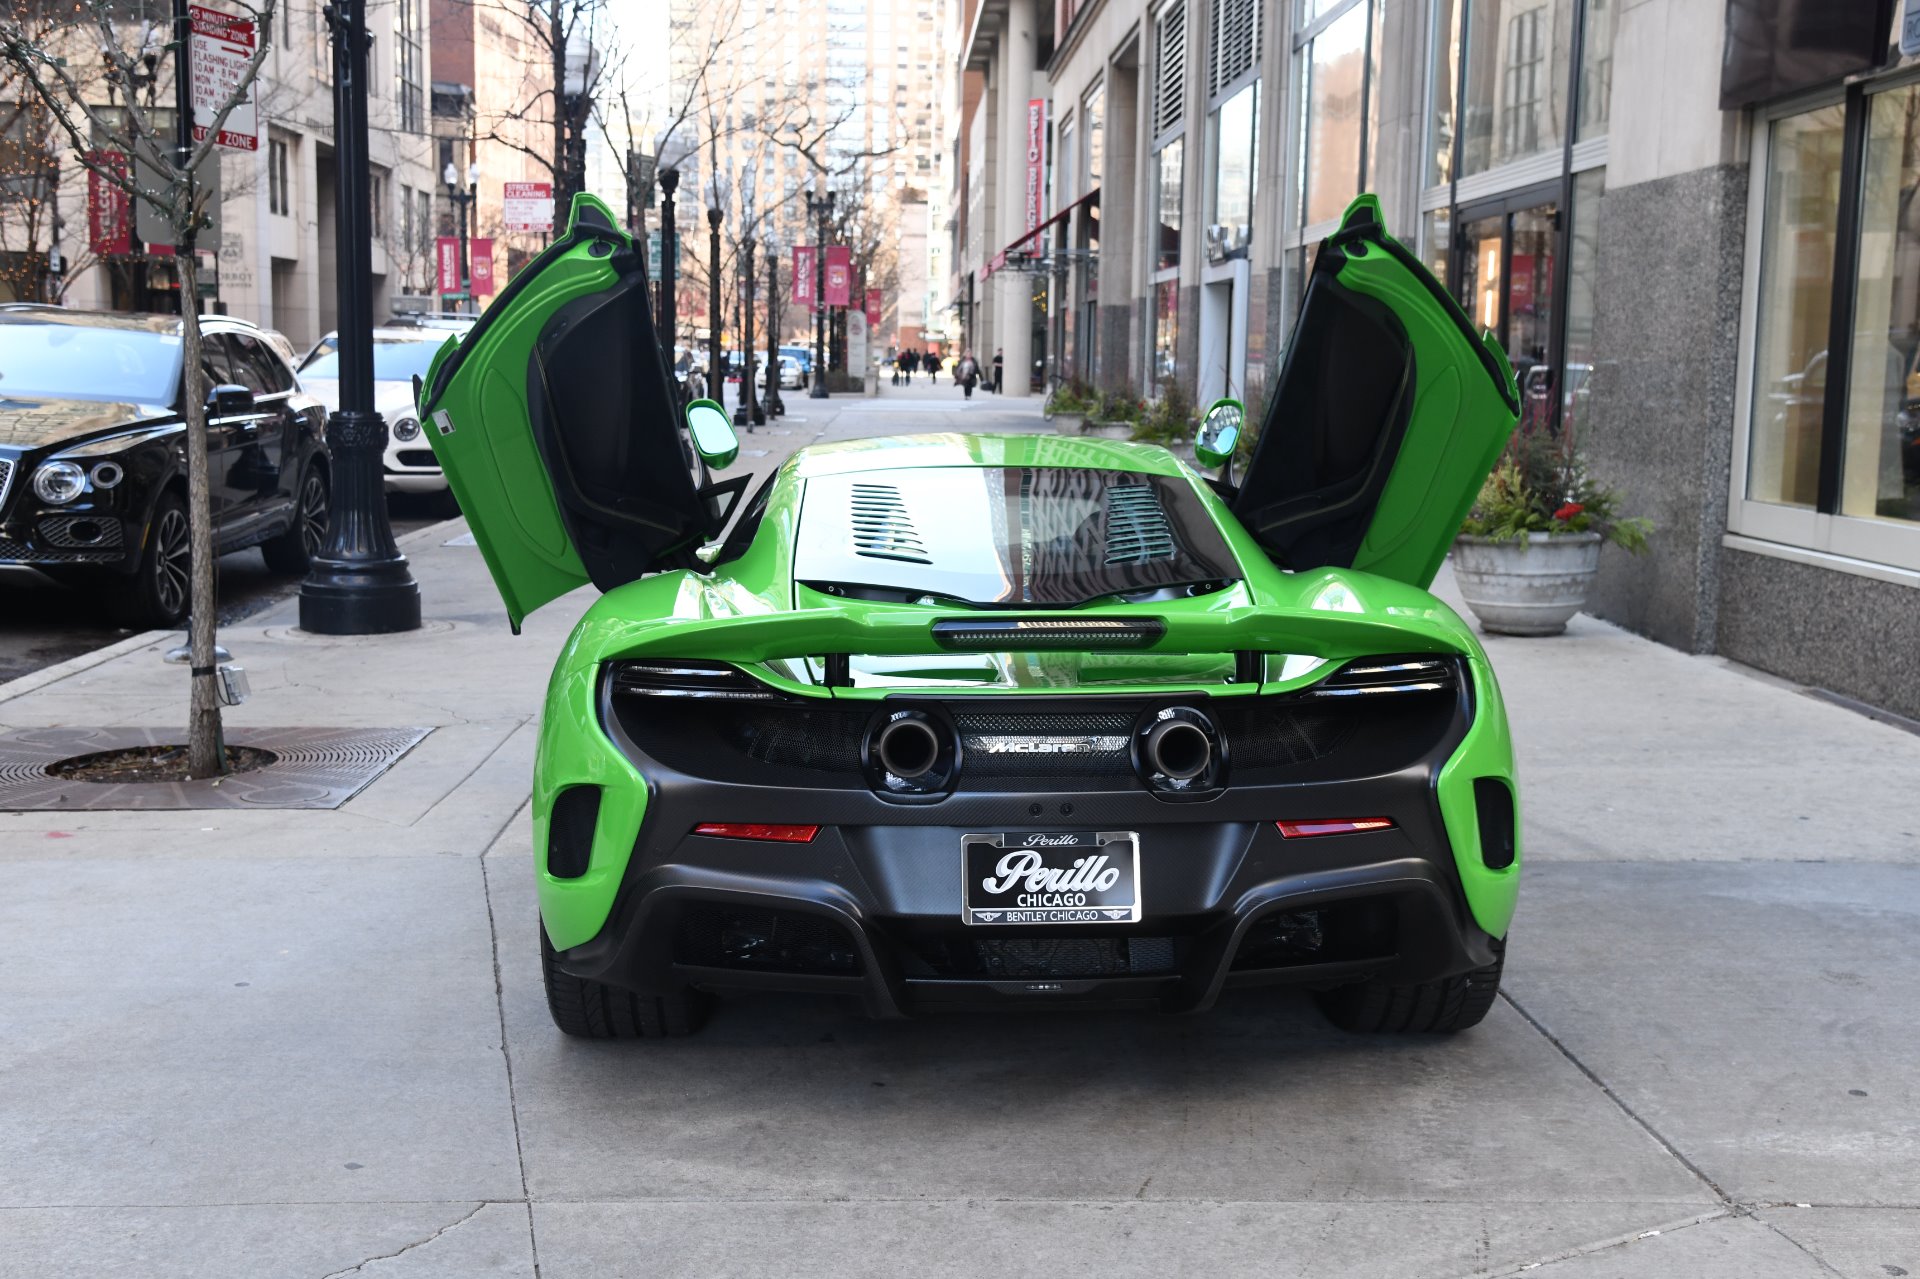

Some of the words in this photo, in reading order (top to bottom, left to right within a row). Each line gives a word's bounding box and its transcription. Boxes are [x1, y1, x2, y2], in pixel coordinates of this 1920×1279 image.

[202, 10, 227, 26] MINUTE
[193, 21, 228, 38] STANDING
[230, 29, 249, 43] ZONE
[194, 40, 208, 51] USE
[193, 50, 228, 68] FLASHING
[230, 60, 250, 71] LIGHT
[194, 62, 202, 72] 10
[204, 64, 214, 74] AM
[228, 70, 238, 80] PM
[194, 74, 210, 85] MON
[219, 78, 237, 92] THUR
[195, 85, 202, 95] 10
[204, 87, 214, 98] AM
[195, 97, 208, 108] FRI
[225, 132, 253, 149] ZONE
[506, 190, 546, 198] CLEANING
[988, 742, 1090, 753] McLaren
[1023, 833, 1079, 847] Perillo
[982, 850, 1120, 894] Perillo
[1017, 893, 1086, 907] CHICAGO
[1006, 911, 1048, 922] BENTLEY
[1050, 910, 1098, 920] CHICAGO
